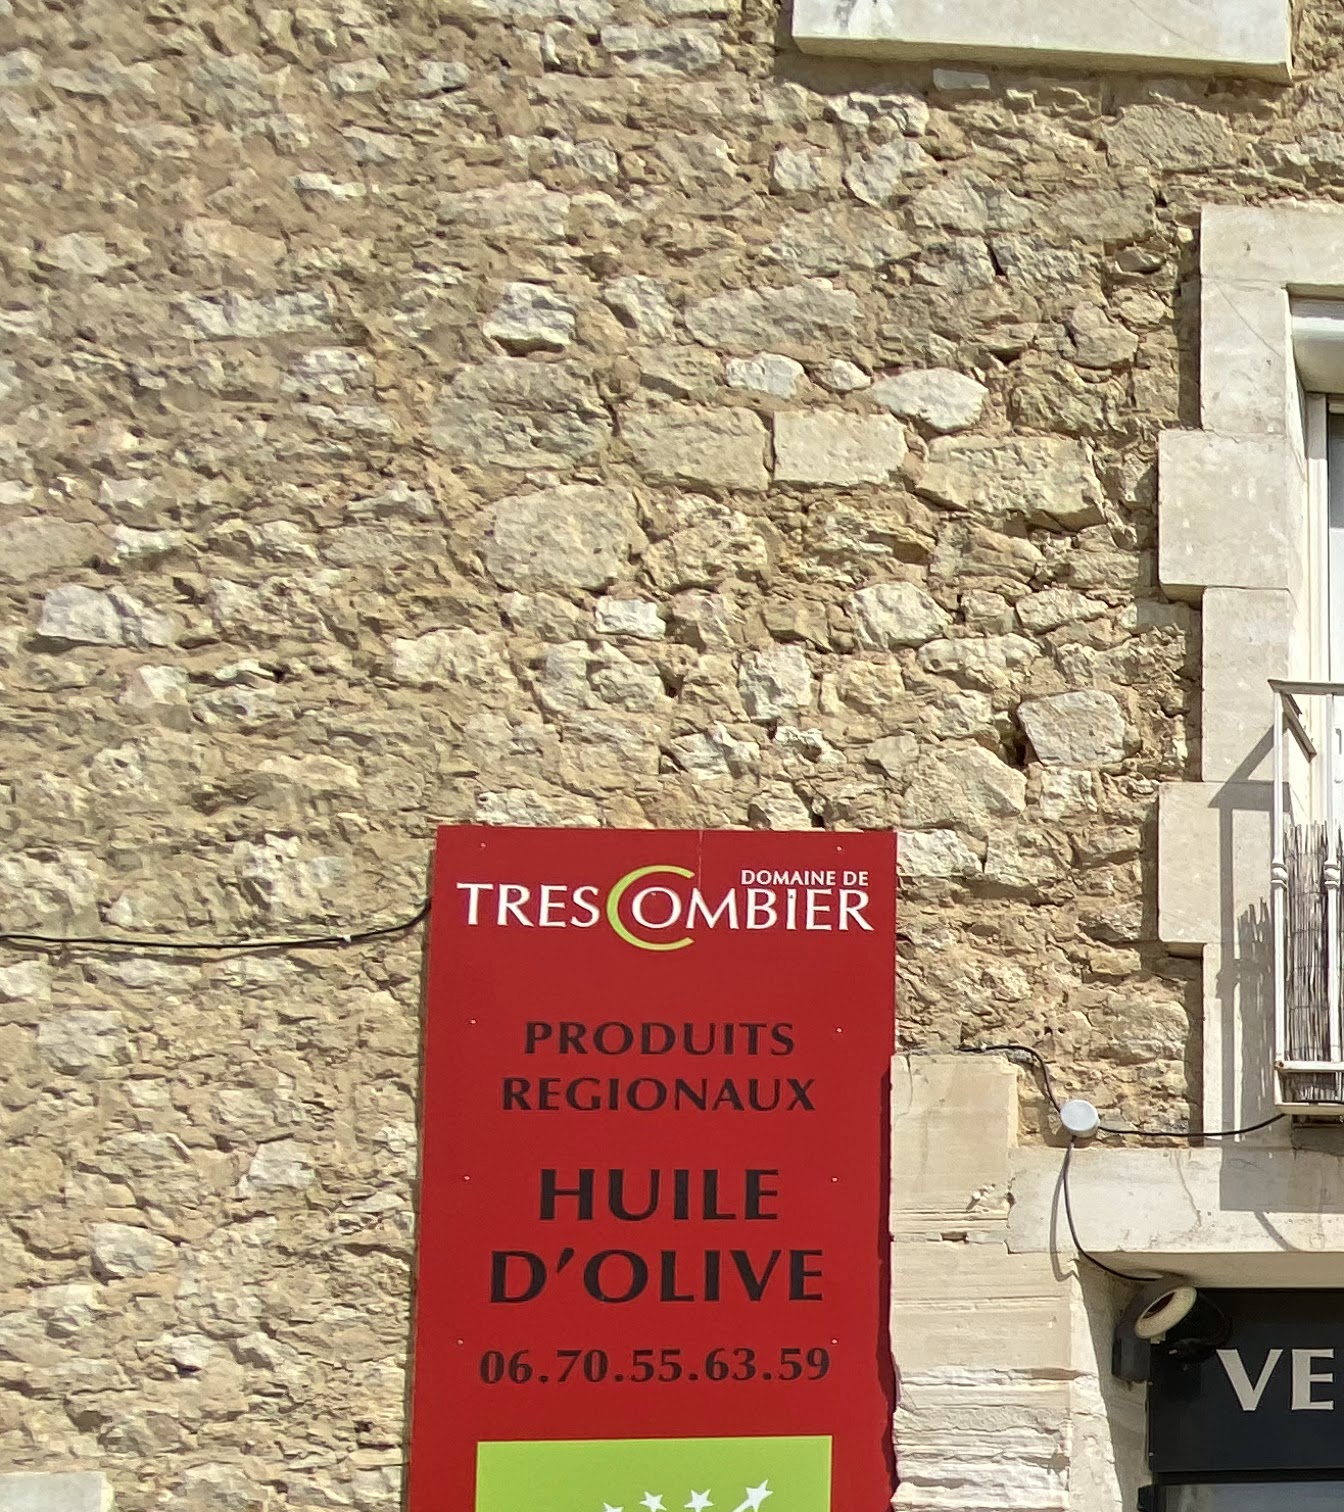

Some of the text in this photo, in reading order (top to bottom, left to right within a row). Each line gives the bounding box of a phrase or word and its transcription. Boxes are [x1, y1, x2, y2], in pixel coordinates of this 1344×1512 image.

[741, 869, 869, 886] DOMAINE DE
[456, 865, 874, 951] TRESCOMBIER
[523, 1020, 795, 1057] PRODUITS
[500, 1076, 816, 1112] REGIONAUX
[538, 1168, 780, 1221] HUILE
[490, 1247, 823, 1304] D'OLIVE
[479, 1348, 830, 1384] 06.70.55.63.59
